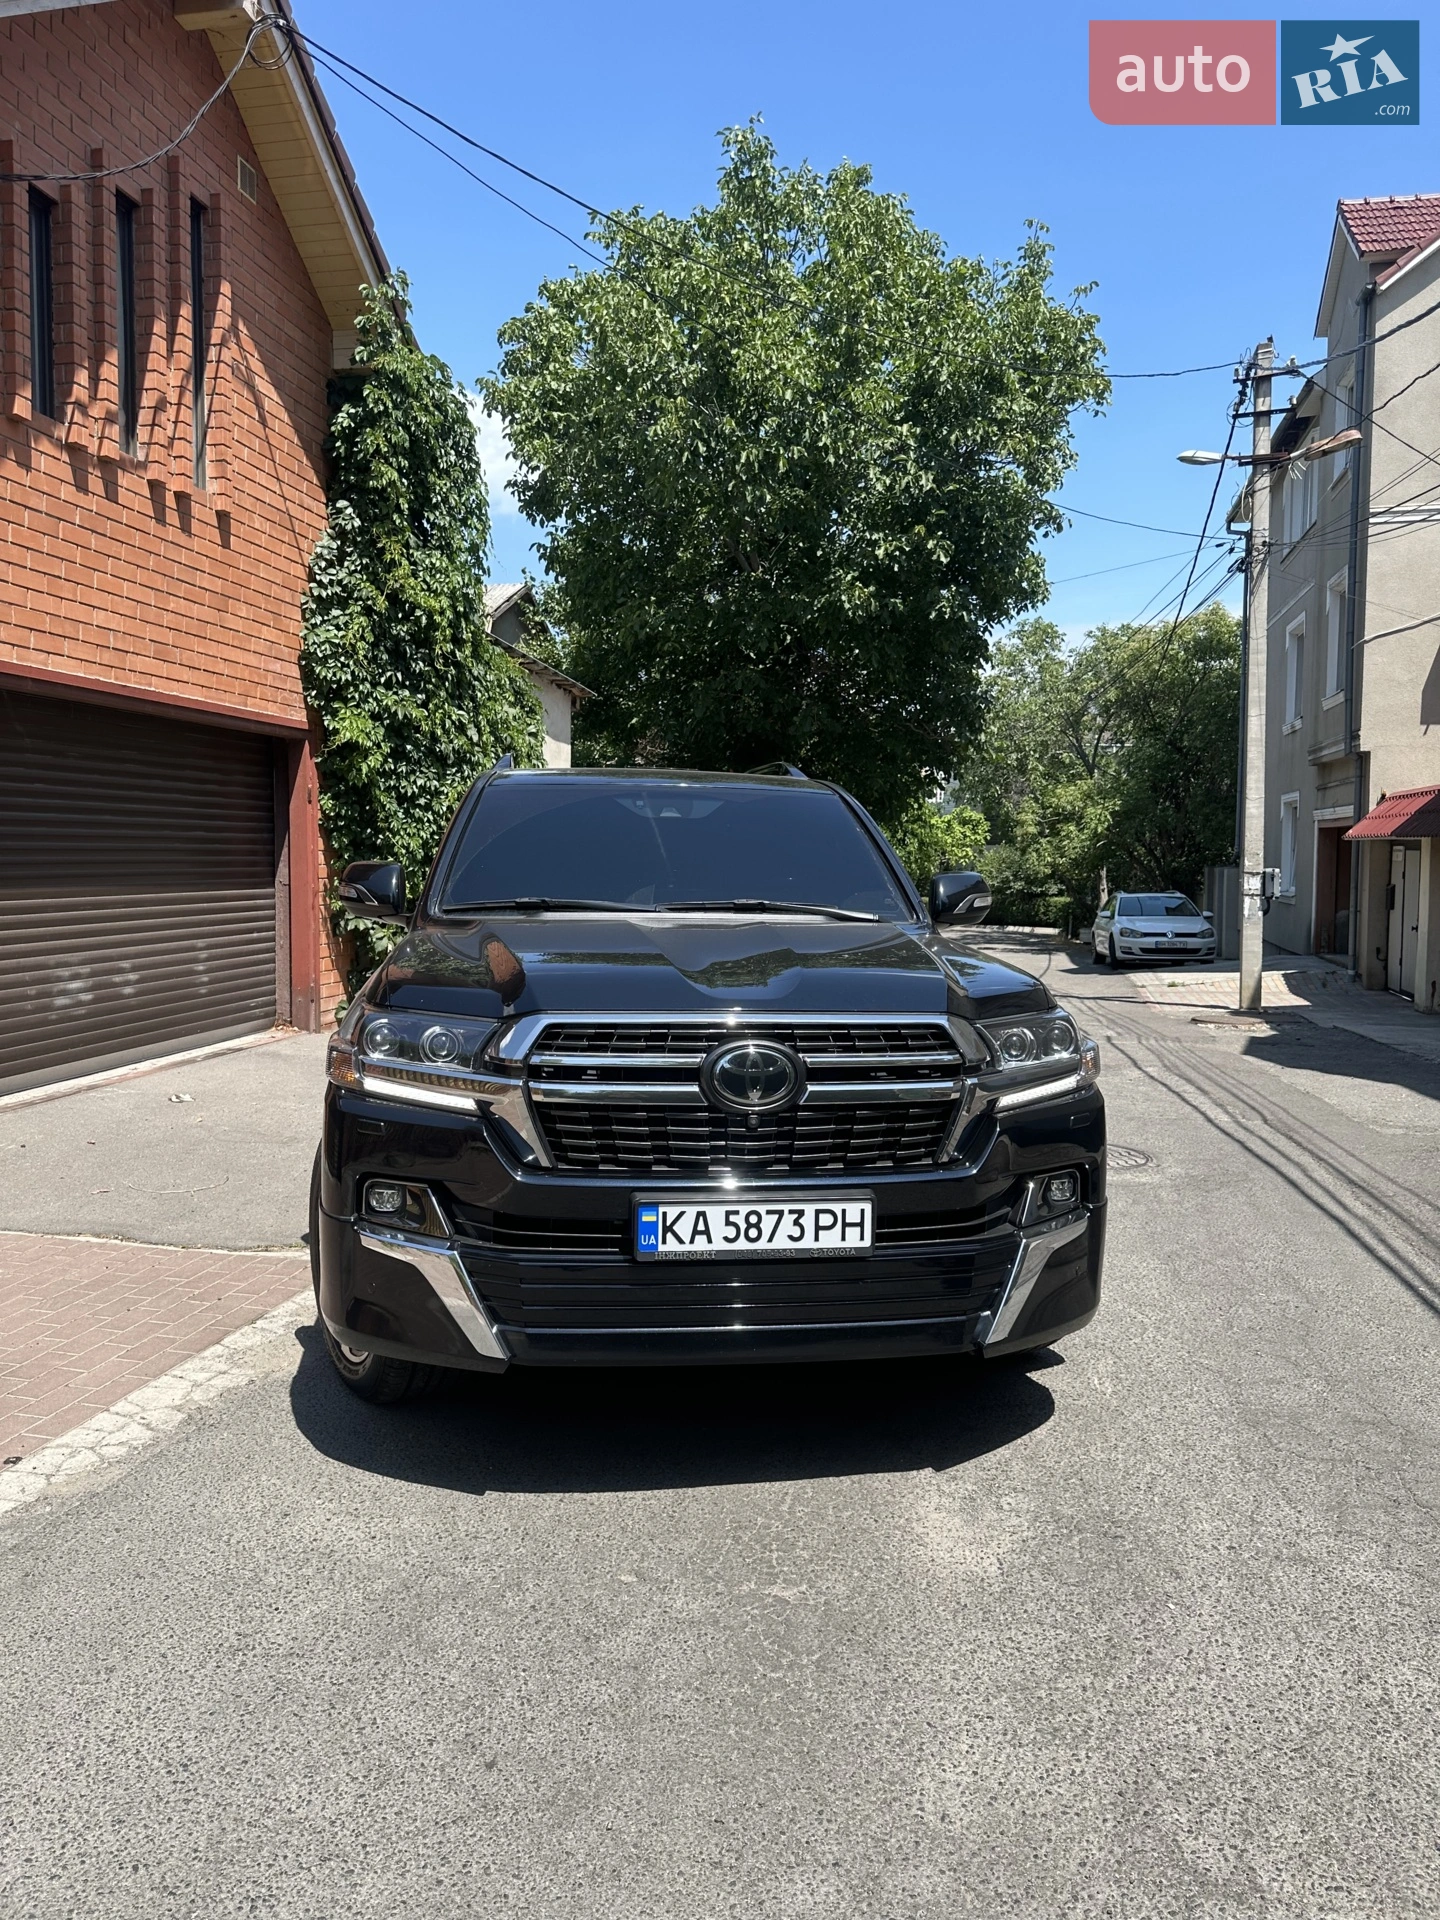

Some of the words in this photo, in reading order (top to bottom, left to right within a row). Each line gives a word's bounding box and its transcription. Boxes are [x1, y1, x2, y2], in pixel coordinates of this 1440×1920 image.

[661, 1210, 714, 1245] KA
[722, 1208, 806, 1244] 5873
[813, 1207, 866, 1242] PH
[641, 1235, 657, 1245] UA
[821, 1248, 856, 1256] TOYOTA
